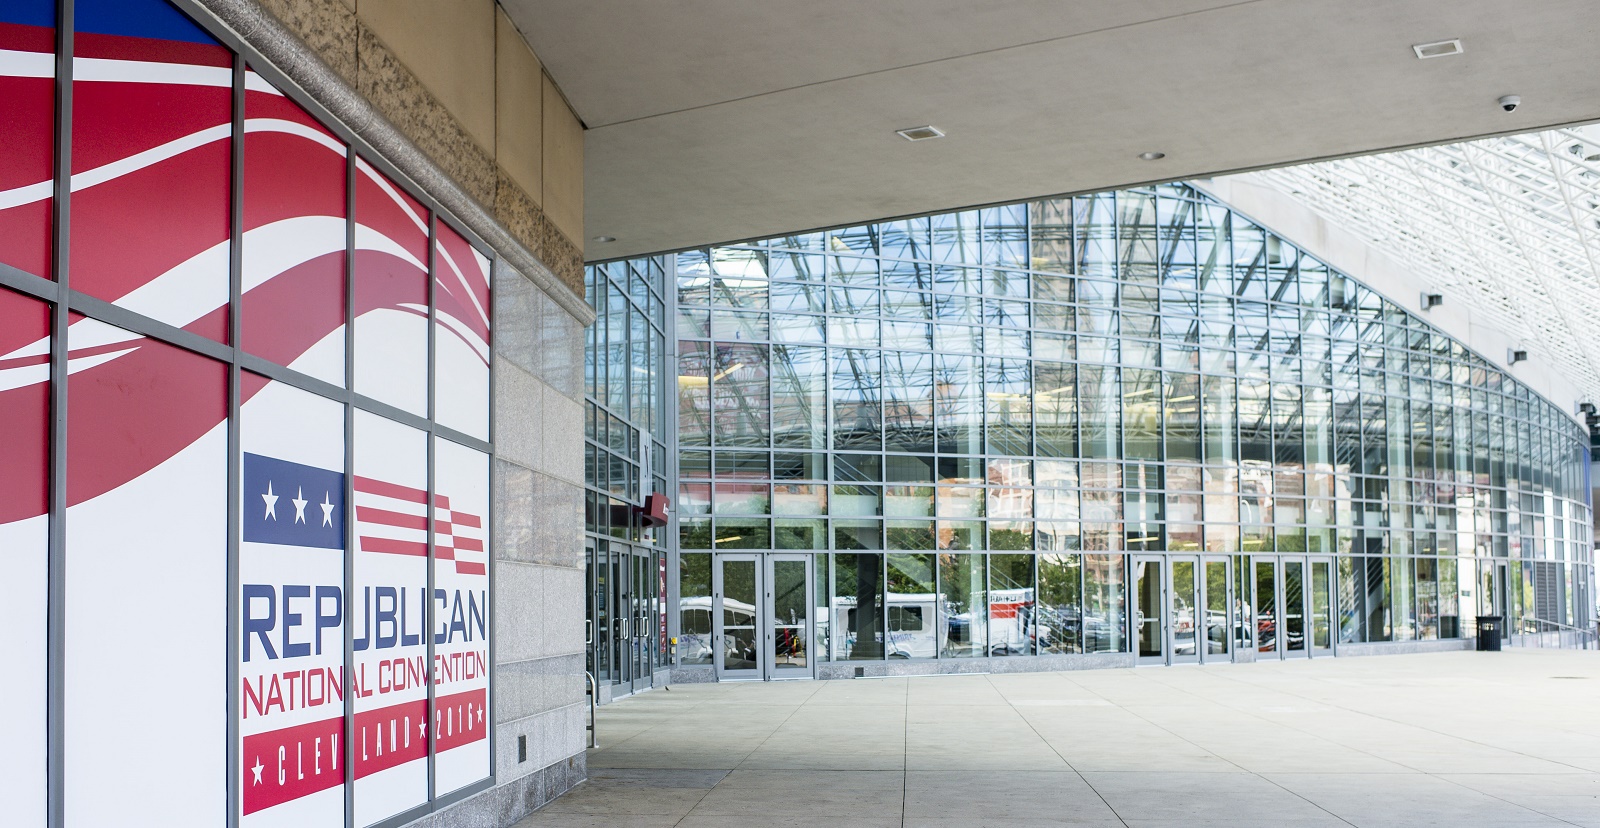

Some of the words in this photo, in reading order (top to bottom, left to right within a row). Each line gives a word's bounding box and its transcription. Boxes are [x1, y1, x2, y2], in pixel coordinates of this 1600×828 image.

[243, 584, 486, 662] REPUBLICAN
[379, 650, 486, 694] CONVENTION
[278, 716, 410, 786] CLEVLAND
[436, 702, 473, 740] 2016
